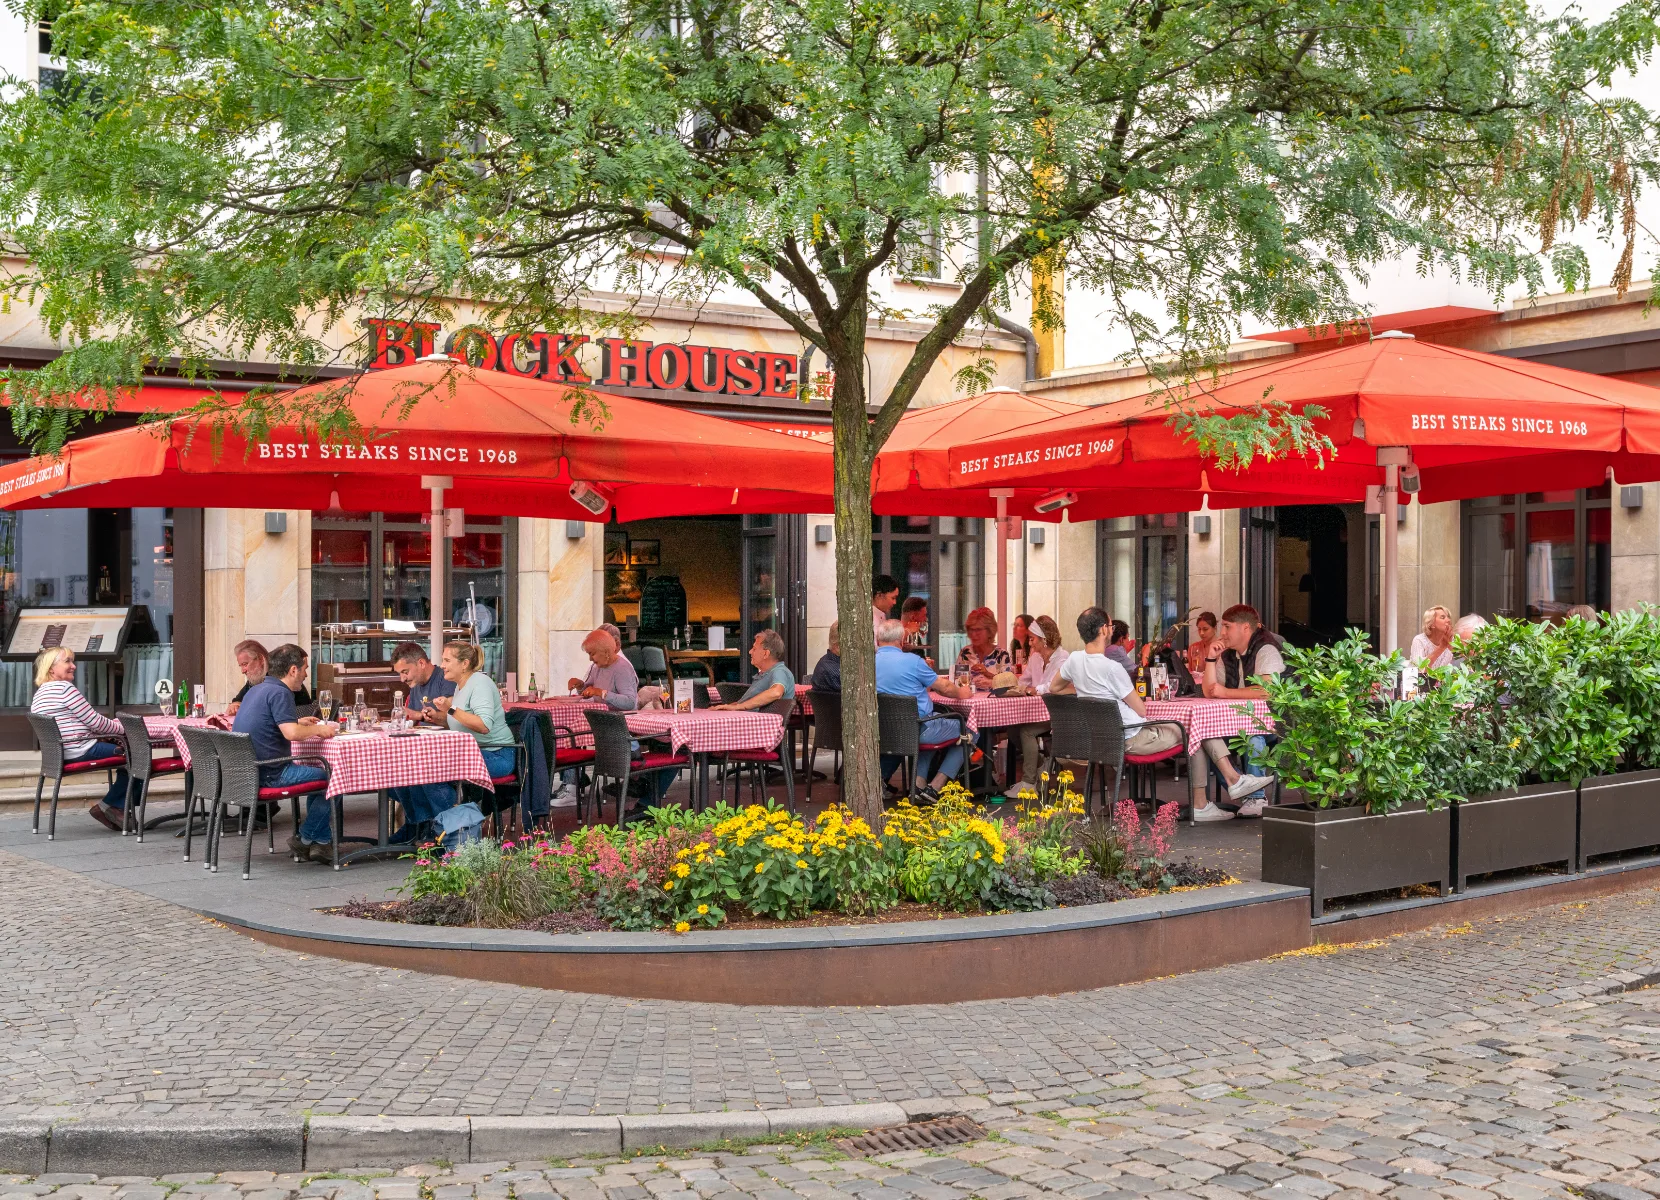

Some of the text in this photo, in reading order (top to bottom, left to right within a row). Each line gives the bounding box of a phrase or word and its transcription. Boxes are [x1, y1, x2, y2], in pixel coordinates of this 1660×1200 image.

[363, 318, 798, 399] BLOCK HOUSE
[1411, 414, 1588, 435] BEST STEAKS SINCE 1968
[259, 443, 517, 464] BEST STEAKS SINCE 1968
[960, 438, 1115, 474] BEST STEAKS SINCE 1968
[157, 681, 172, 694] A
